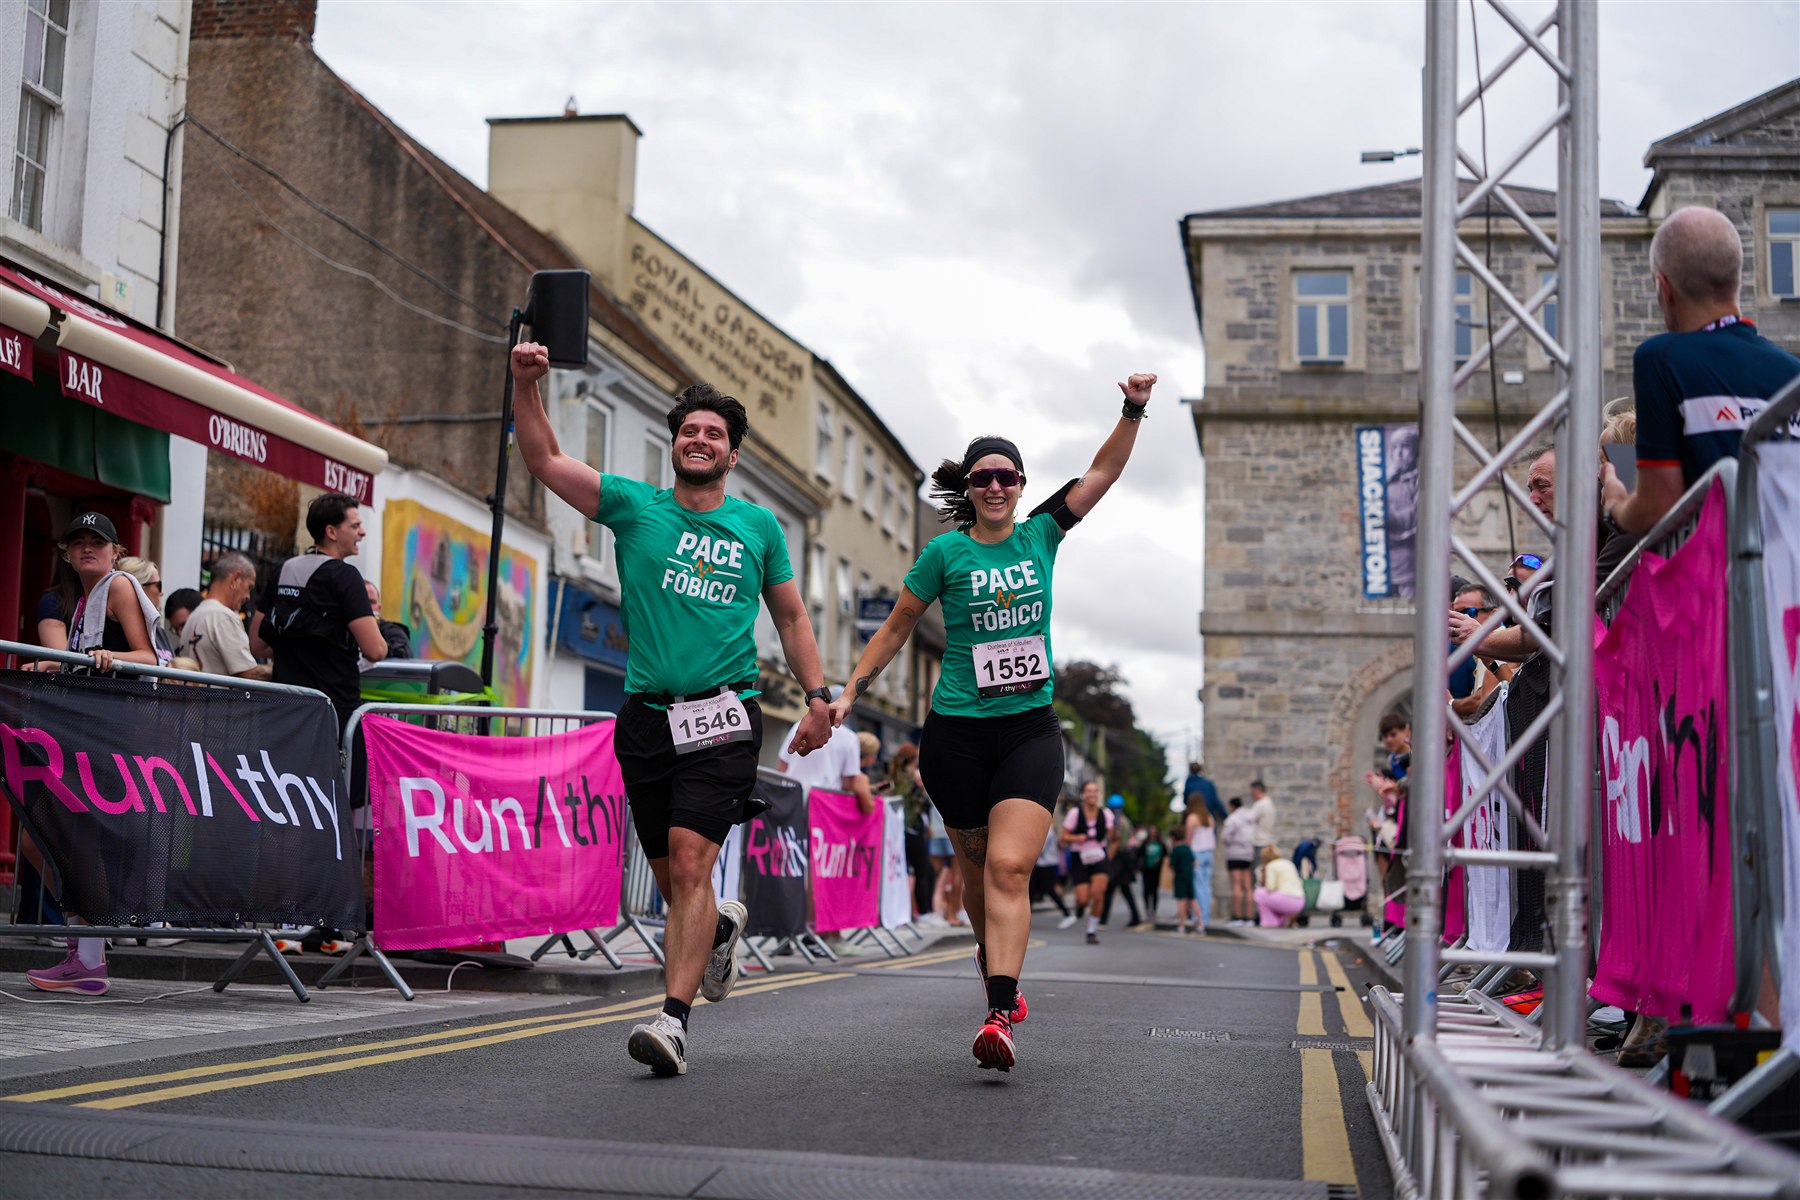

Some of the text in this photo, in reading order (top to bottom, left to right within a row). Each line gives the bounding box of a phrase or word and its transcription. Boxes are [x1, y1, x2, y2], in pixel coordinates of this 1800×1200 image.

[630, 244, 804, 382] ROYAL GARDEN
[66, 355, 103, 404] BAR
[209, 414, 267, 463] O'BRIENS
[1360, 430, 1388, 594] SHACKLETON
[675, 531, 744, 569] PACE
[661, 568, 736, 604] FÓBICO
[970, 559, 1039, 596] PACE
[971, 600, 1043, 632] FÓBICO
[983, 653, 1042, 681] 1552
[679, 707, 741, 739] 1546
